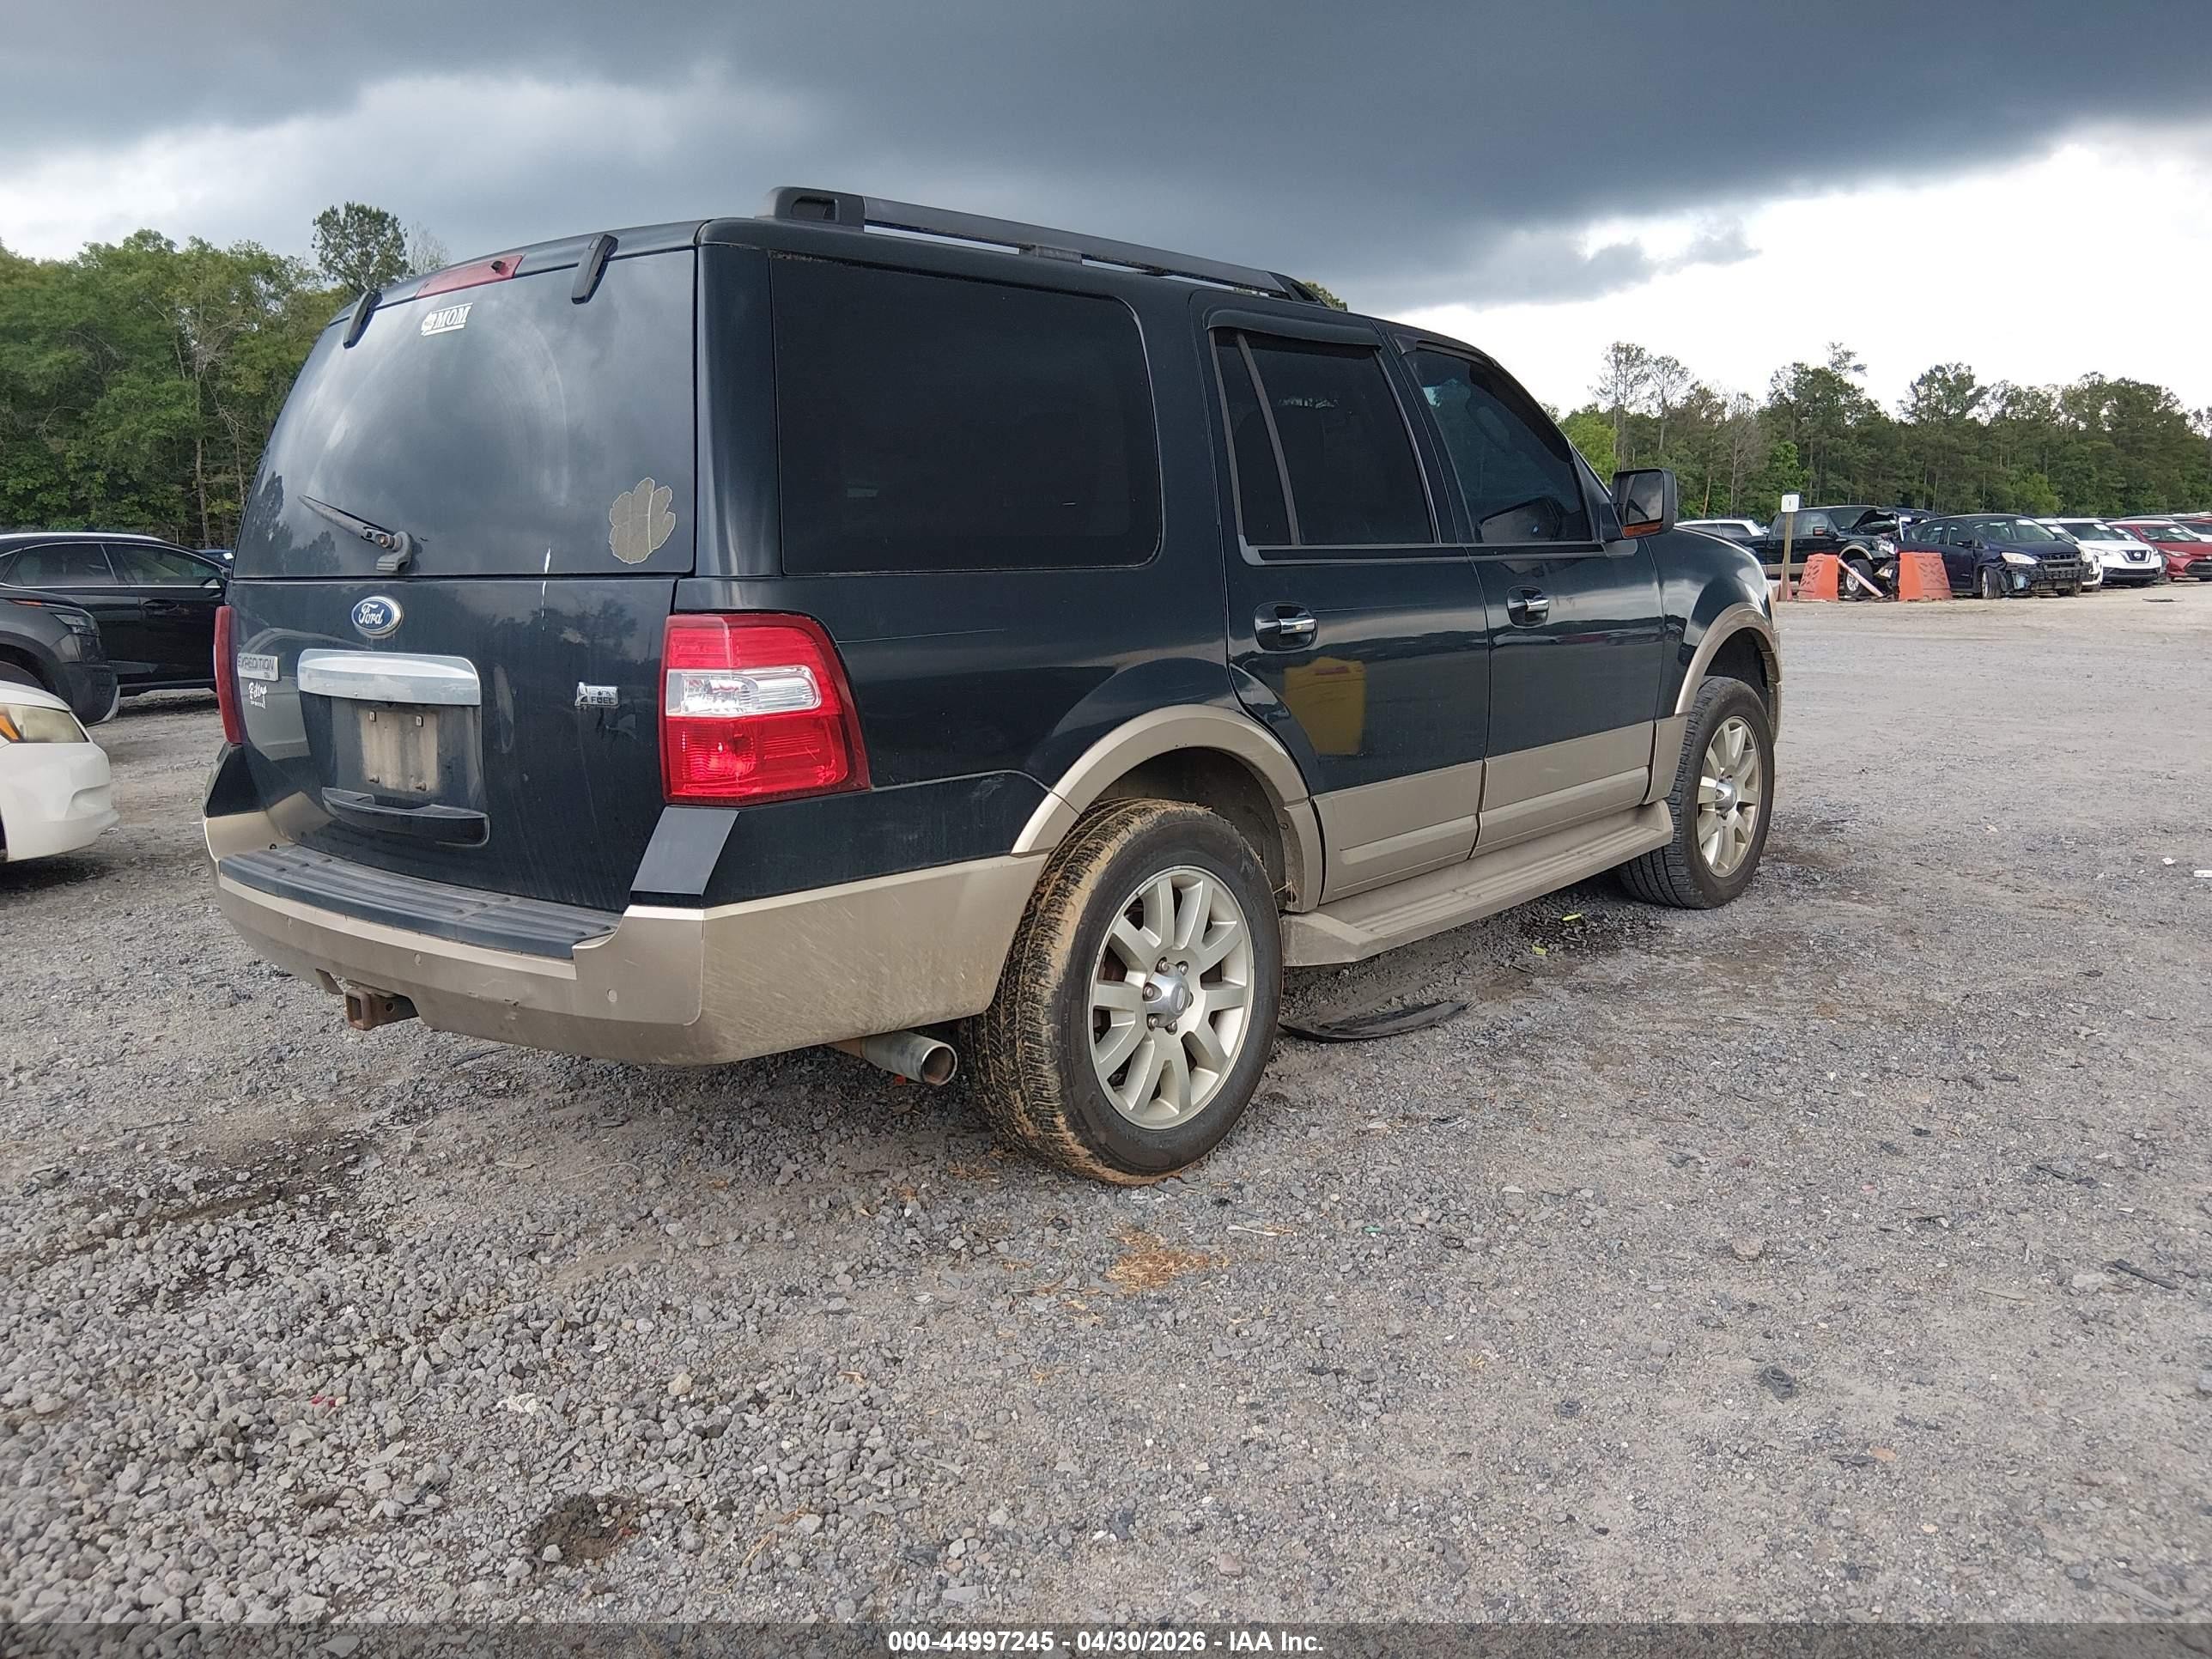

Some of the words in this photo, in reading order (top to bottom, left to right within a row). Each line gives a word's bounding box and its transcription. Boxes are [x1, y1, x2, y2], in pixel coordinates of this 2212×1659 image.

[433, 306, 471, 329] MOM
[358, 603, 385, 624] Ford
[238, 655, 275, 671] EXPEDITION
[591, 696, 615, 704] FUEL
